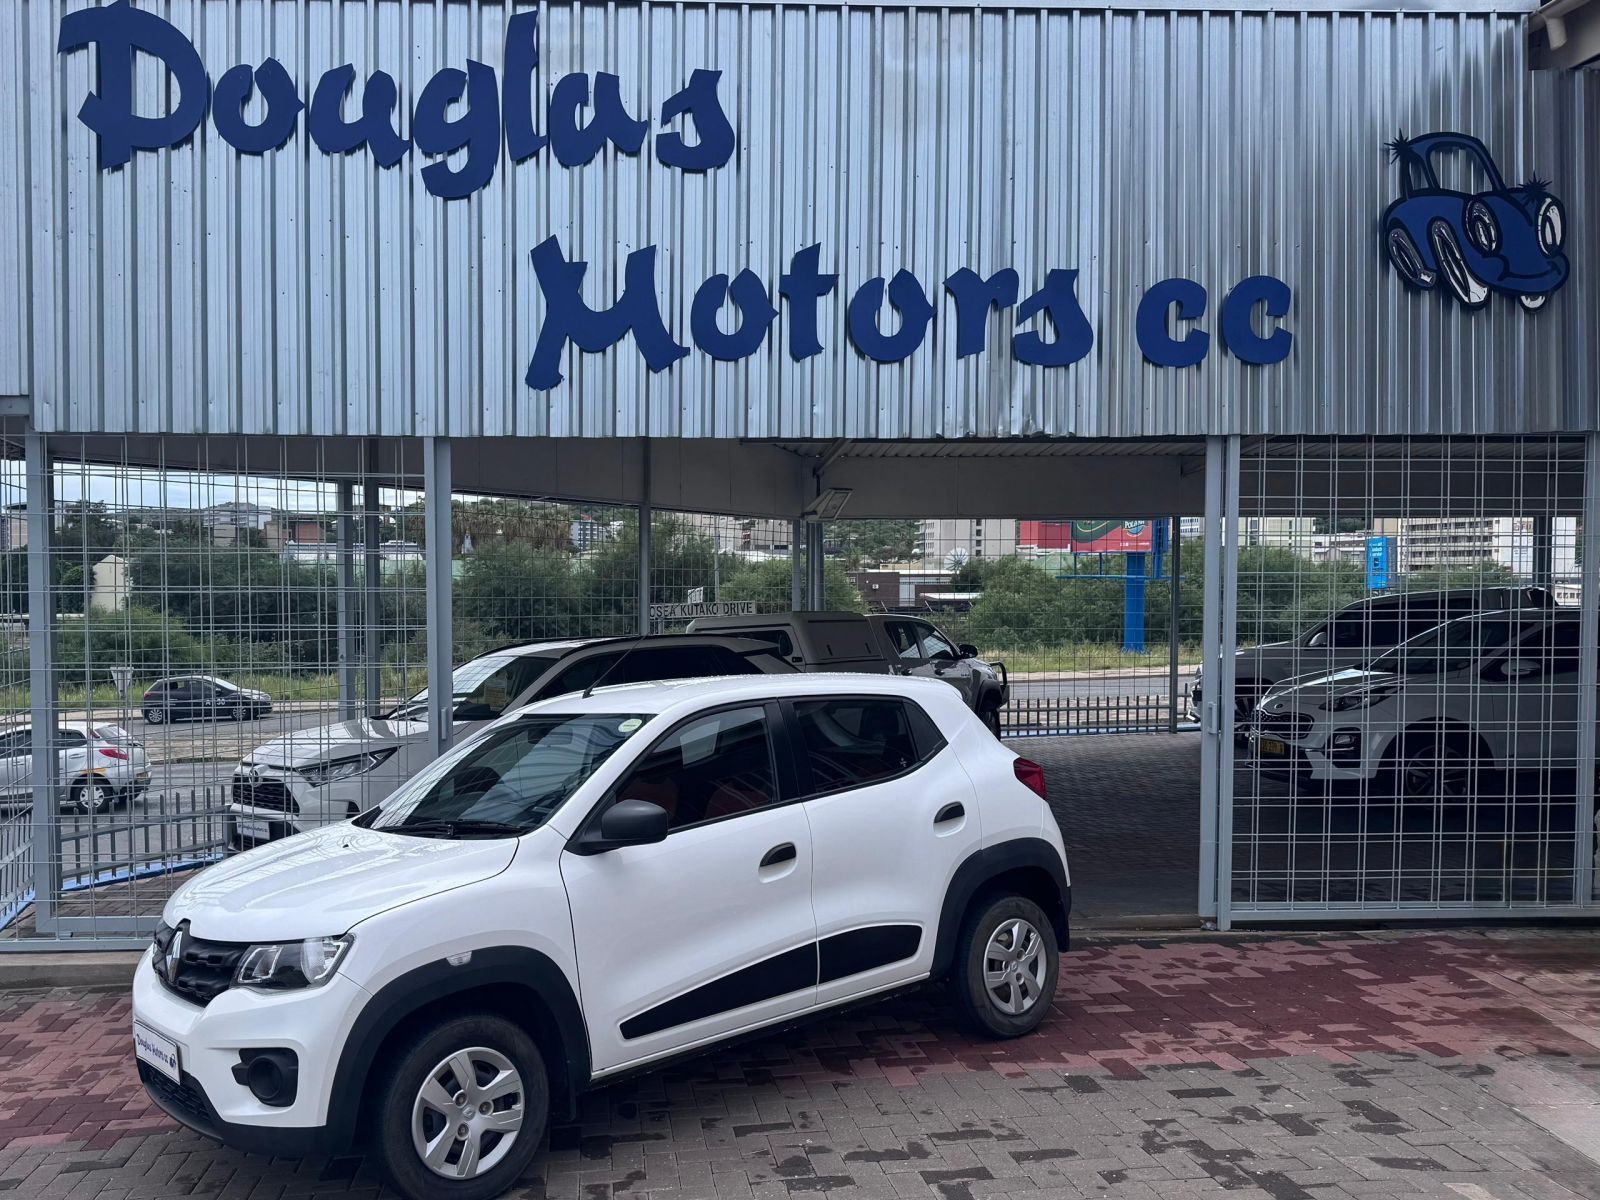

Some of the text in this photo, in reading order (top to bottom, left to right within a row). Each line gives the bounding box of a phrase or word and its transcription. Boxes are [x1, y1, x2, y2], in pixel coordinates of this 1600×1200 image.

[57, 0, 736, 200] Douglas
[525, 234, 1294, 391] Motors cc
[649, 601, 753, 618] OSEA KUTAKO DRIVE
